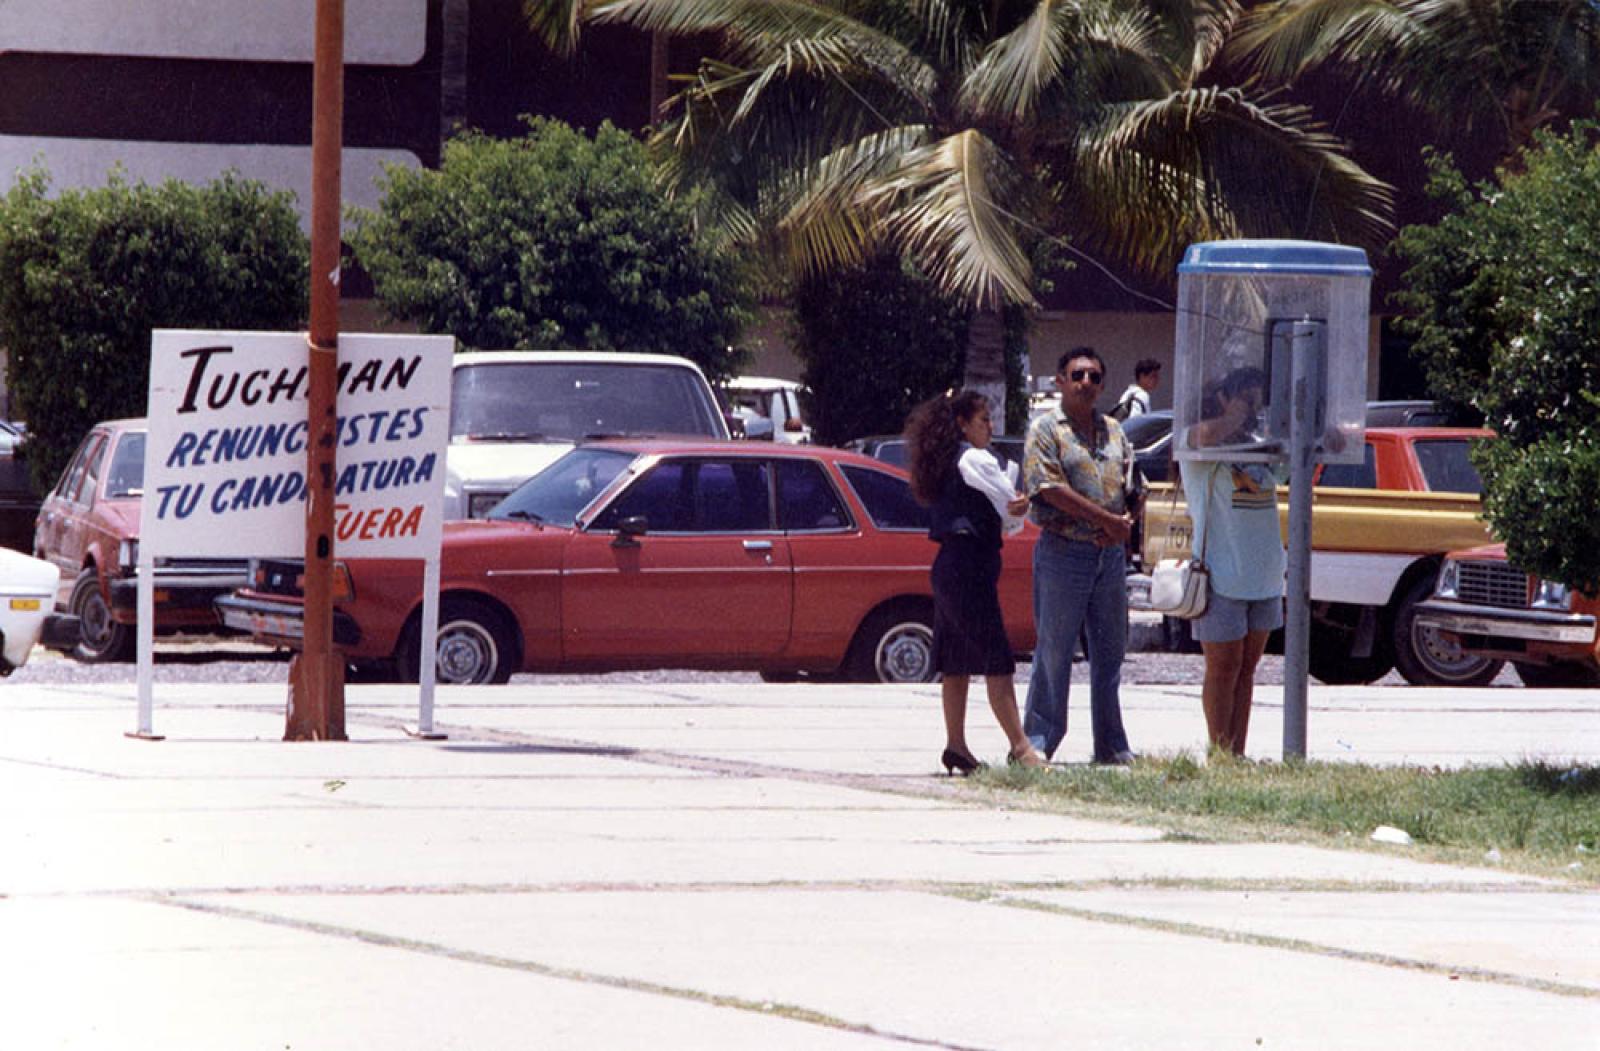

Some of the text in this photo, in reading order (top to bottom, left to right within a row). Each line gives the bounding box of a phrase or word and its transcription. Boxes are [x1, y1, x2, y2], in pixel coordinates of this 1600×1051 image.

[166, 406, 429, 468] RENUNCSTES
[156, 453, 437, 520] TU CANDATURA
